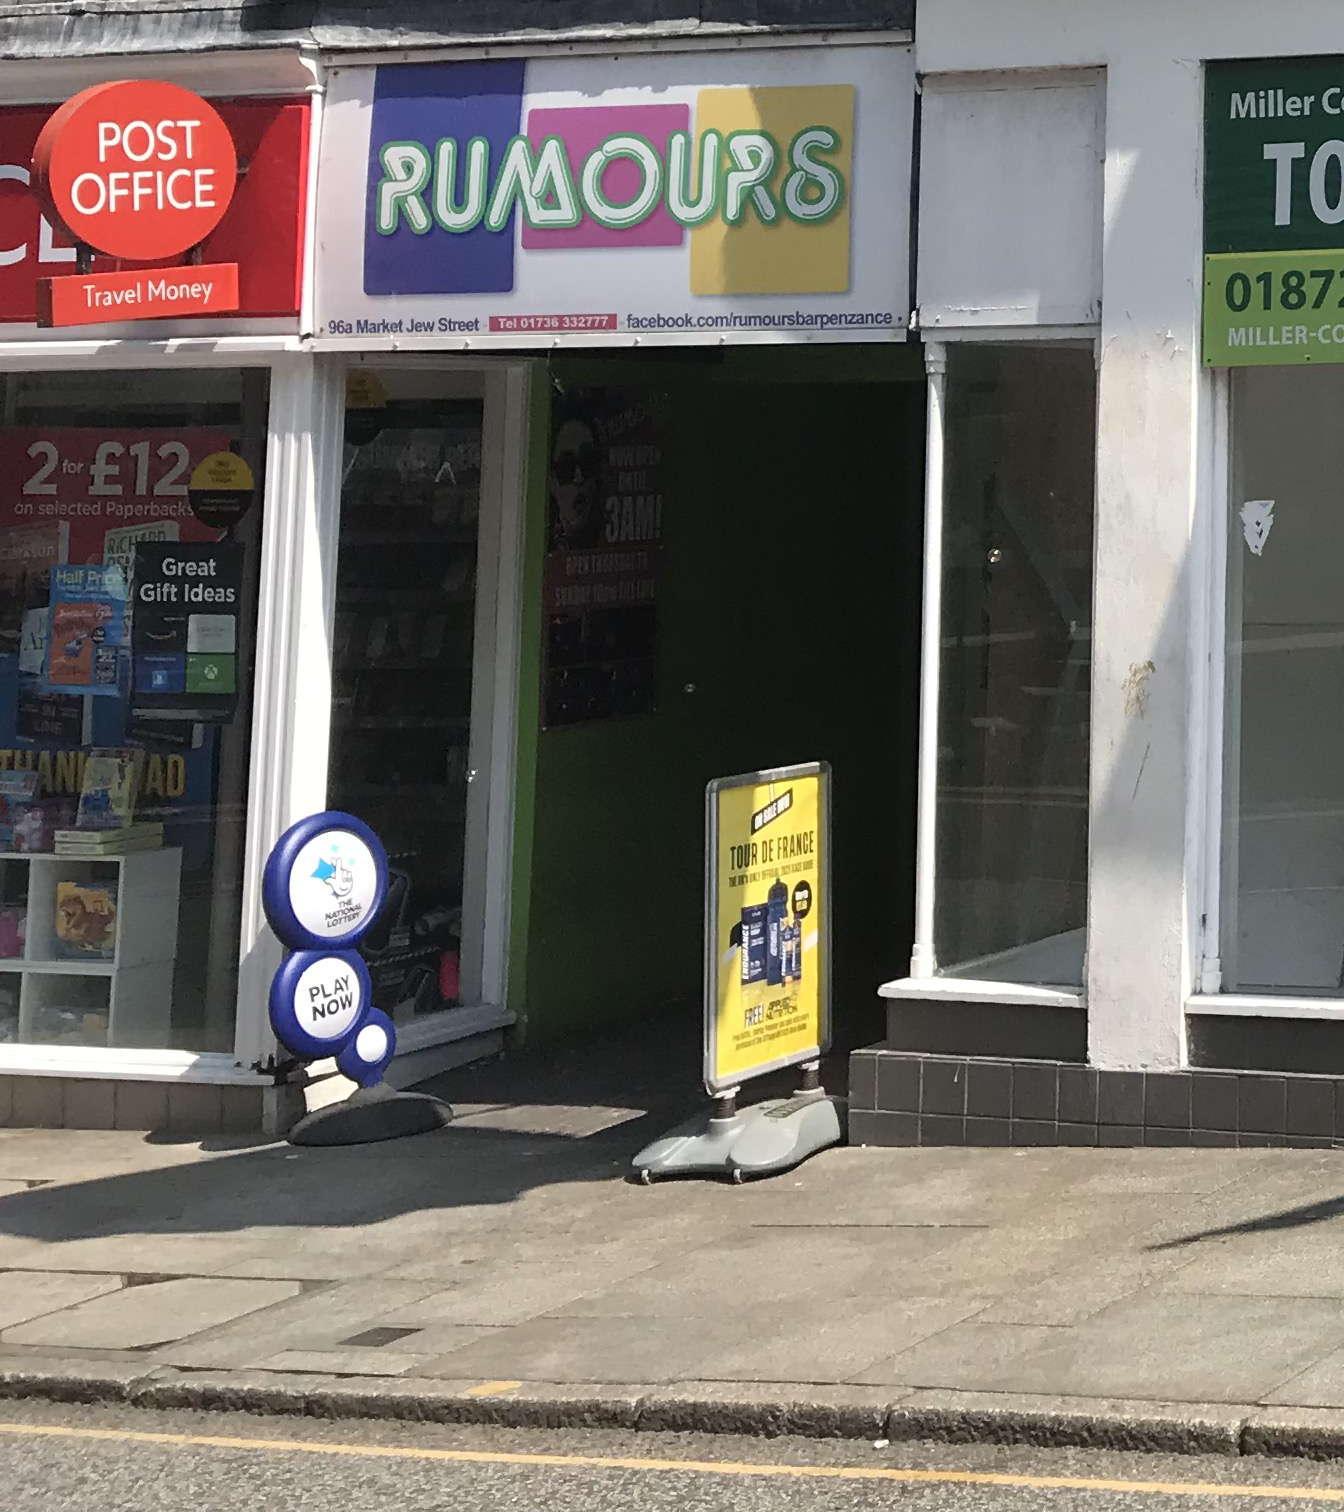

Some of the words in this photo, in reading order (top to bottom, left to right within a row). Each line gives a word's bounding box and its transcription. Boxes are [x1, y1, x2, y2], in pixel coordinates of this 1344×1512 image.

[1230, 89, 1315, 119] Miller
[98, 120, 200, 163] POST
[71, 168, 216, 216] OFFICE
[375, 126, 843, 236] RUMOURS
[83, 283, 141, 308] Travel
[148, 280, 213, 305] Money
[328, 319, 354, 335] 96a
[356, 318, 403, 334] Market
[406, 318, 435, 333] Jew
[437, 317, 479, 333] Street
[498, 316, 517, 329] Tel
[562, 315, 609, 328] 332777
[626, 310, 893, 330] facebook.com/rumoursbarpenzance
[22, 441, 58, 495] 2
[62, 459, 84, 474] for
[88, 441, 190, 496] £12
[14, 502, 33, 515] on
[38, 500, 100, 516] selected
[106, 500, 194, 519] Paperbacks
[605, 494, 662, 543] 3AM!
[56, 569, 85, 584] Half
[162, 557, 217, 576] Great
[140, 583, 178, 602] Gift
[184, 583, 236, 603] Ideas
[730, 843, 758, 871] TOUR
[762, 838, 774, 864] DE
[777, 830, 814, 860] FRANCE
[325, 903, 362, 921] NATIONAL
[338, 898, 353, 909] THE
[327, 911, 361, 928] LOTTERY
[308, 975, 351, 1004] PLAY
[311, 992, 354, 1022] NOW
[745, 1004, 764, 1029] FREE!
